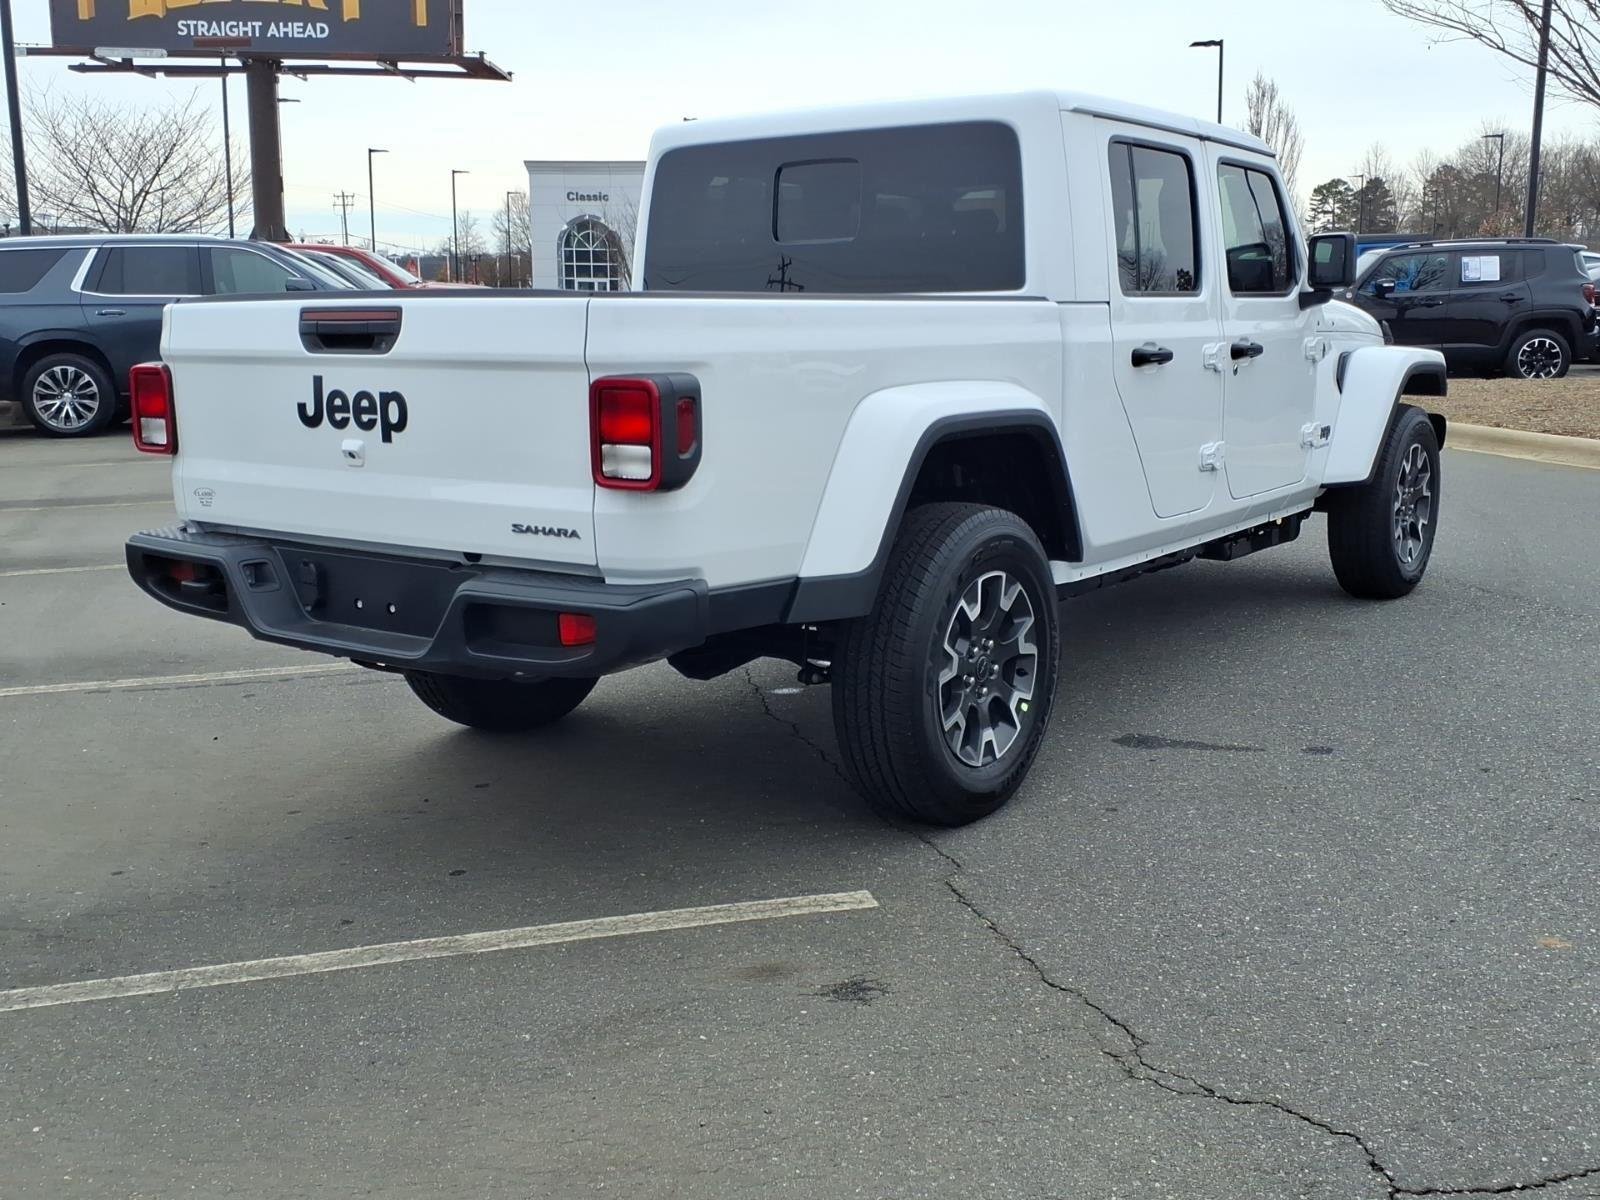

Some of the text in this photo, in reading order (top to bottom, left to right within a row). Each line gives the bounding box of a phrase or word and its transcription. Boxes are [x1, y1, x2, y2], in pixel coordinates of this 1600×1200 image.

[177, 20, 329, 38] STRAIGHT AHEAD
[566, 191, 609, 201] Classic
[297, 375, 408, 443] Jeep
[511, 523, 582, 540] SAHARA
